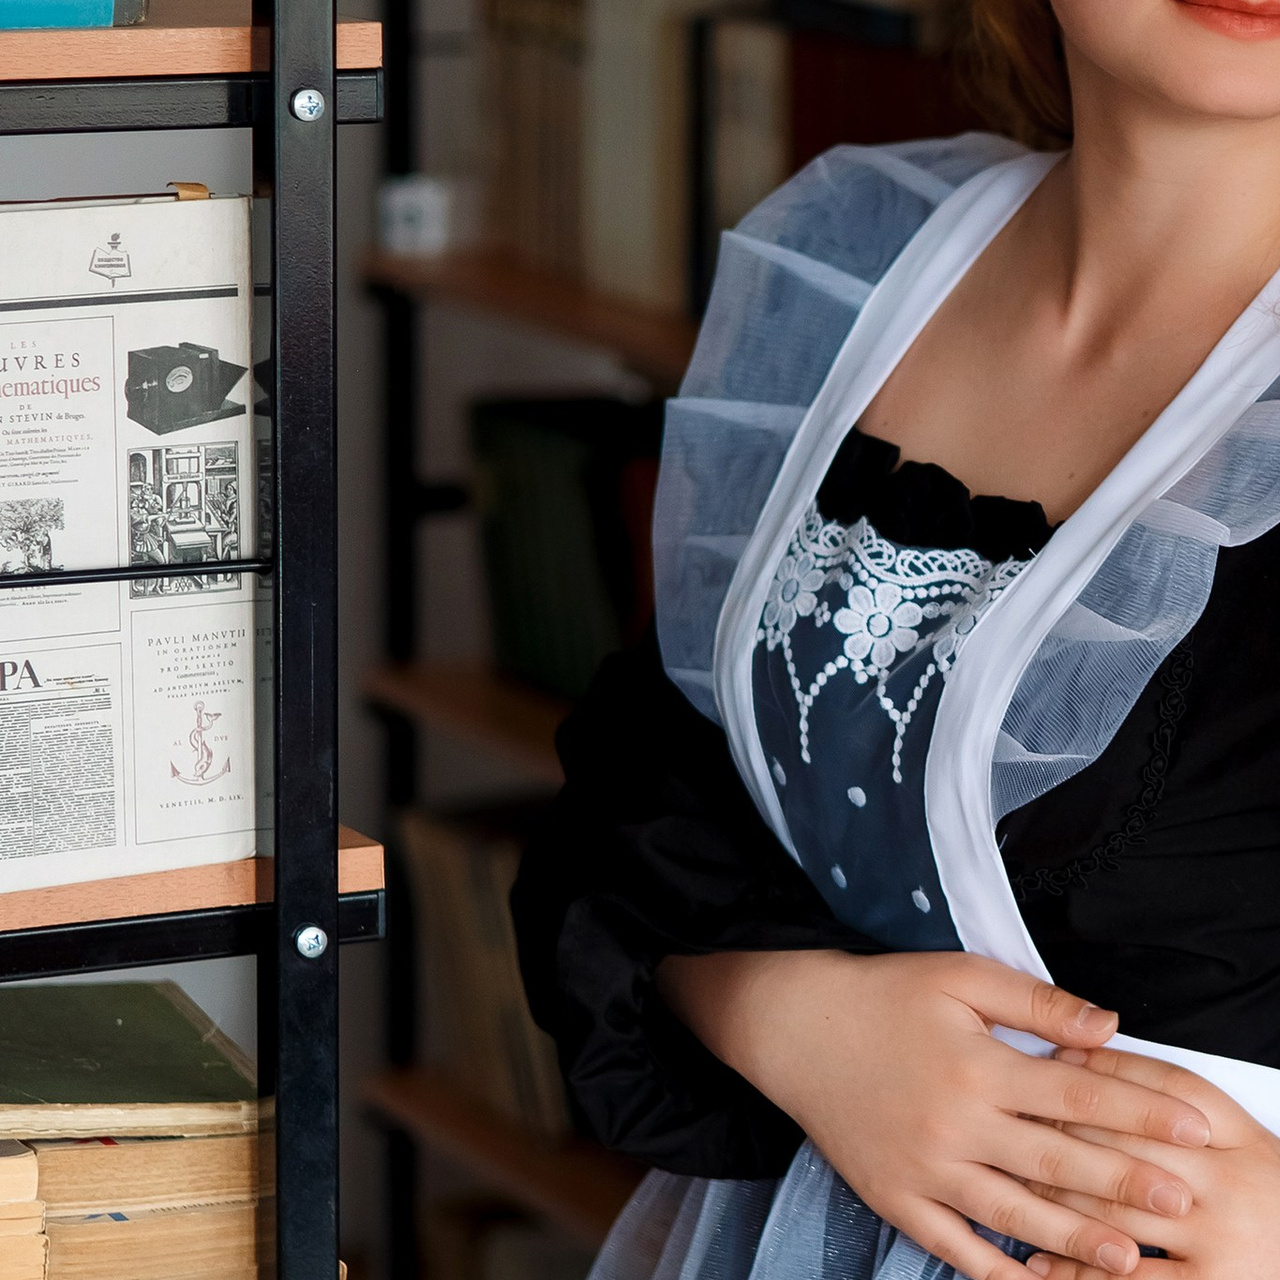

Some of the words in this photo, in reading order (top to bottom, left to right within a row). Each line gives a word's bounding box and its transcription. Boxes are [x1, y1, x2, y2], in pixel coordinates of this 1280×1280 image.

[10, 340, 37, 350] LES
[9, 412, 53, 423] STEVIN
[148, 636, 185, 647] PAVLI
[192, 628, 246, 642] MANVTII
[174, 642, 237, 654] ORATIONEM
